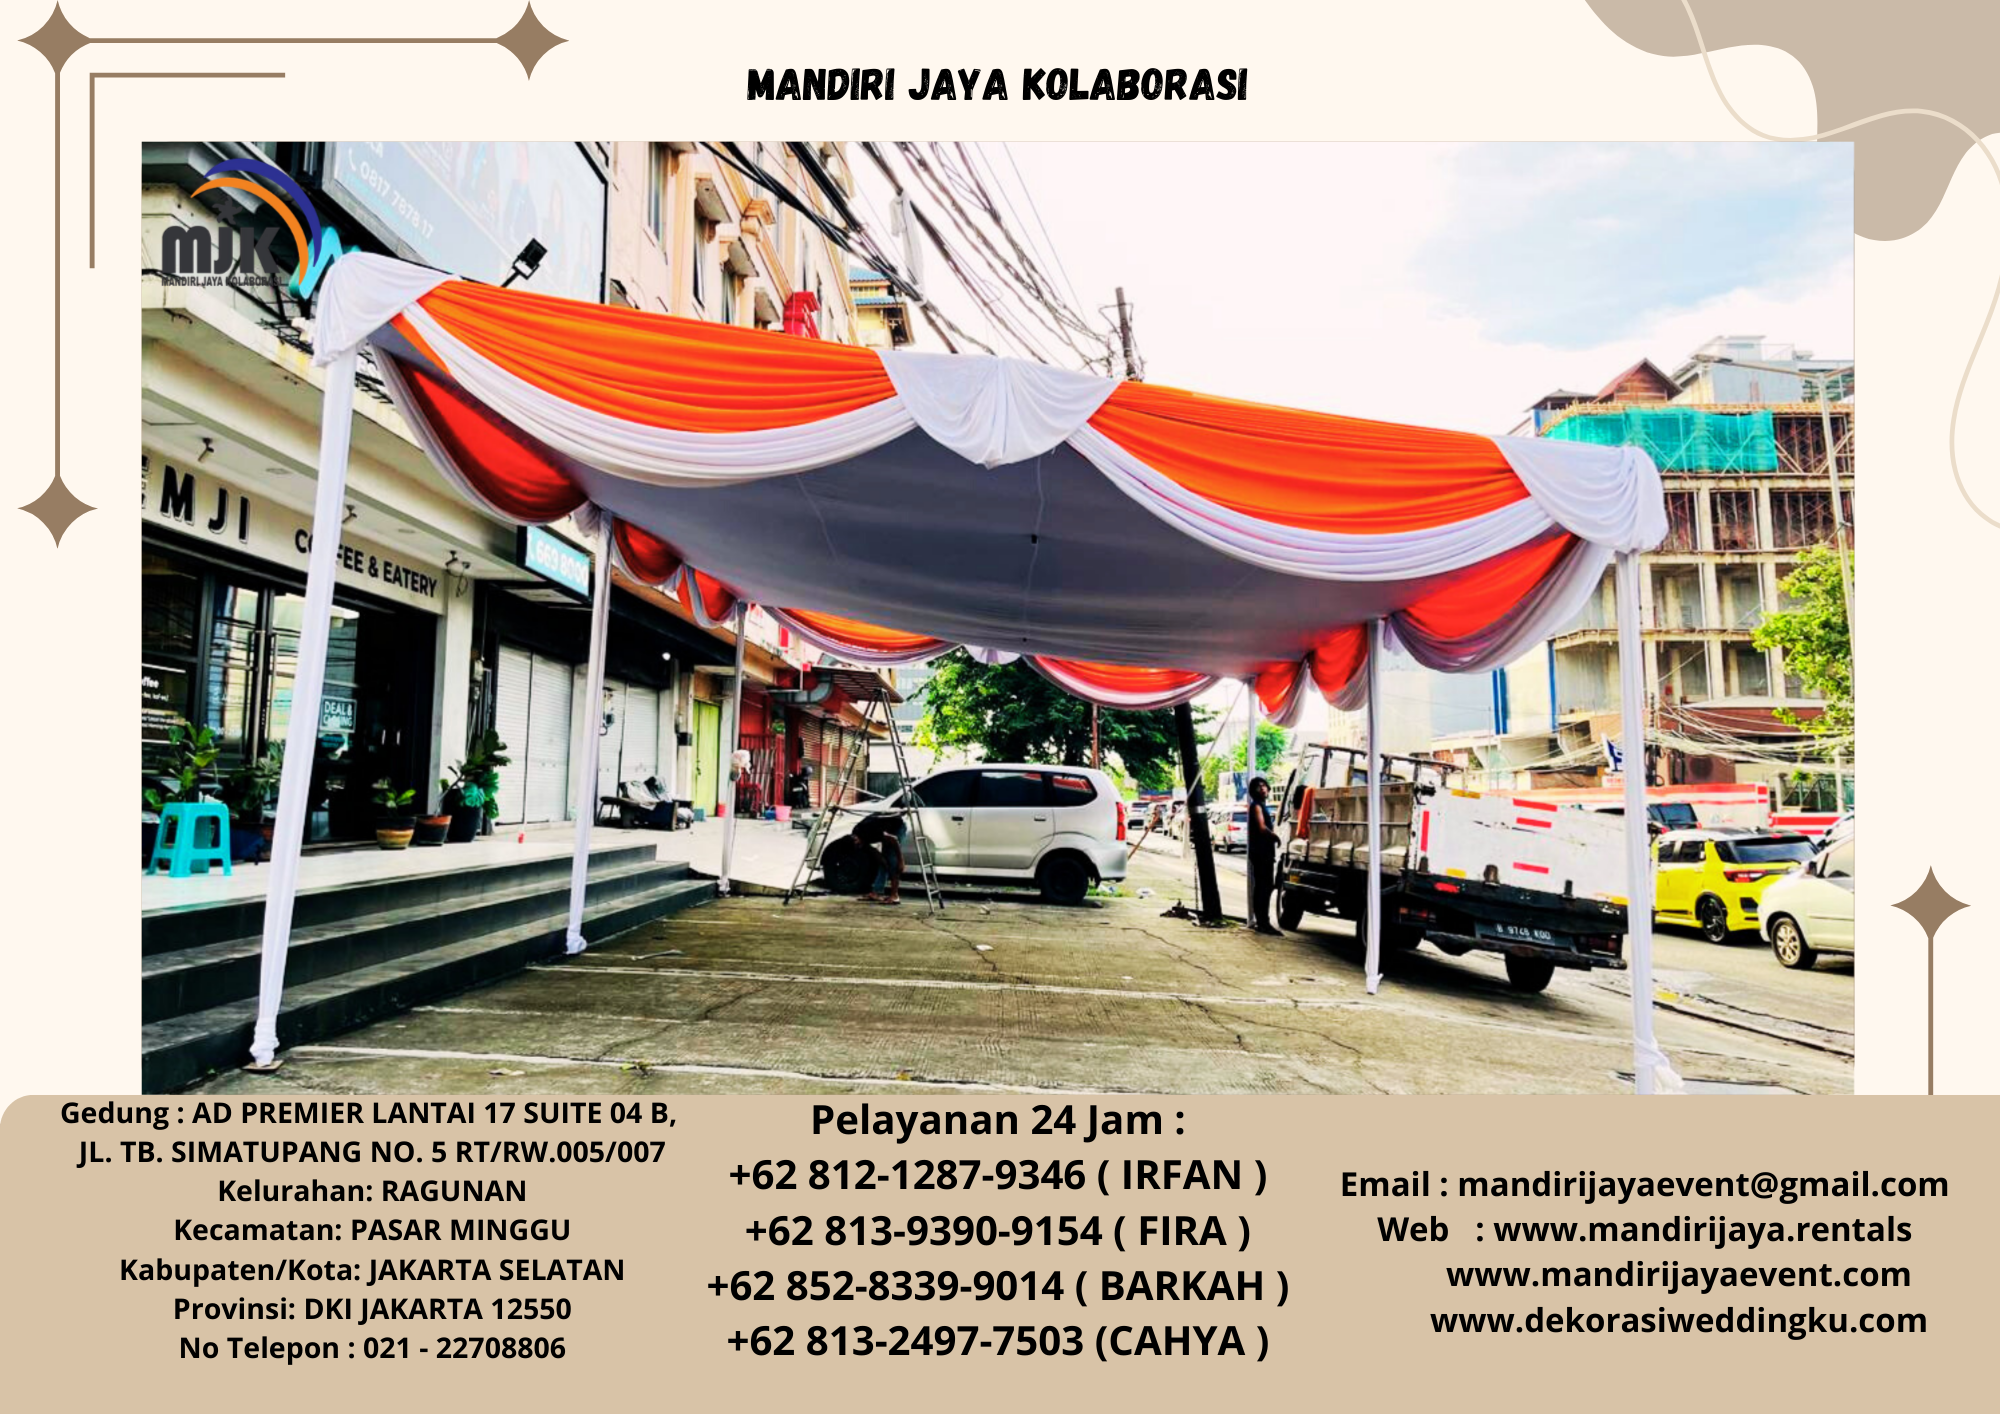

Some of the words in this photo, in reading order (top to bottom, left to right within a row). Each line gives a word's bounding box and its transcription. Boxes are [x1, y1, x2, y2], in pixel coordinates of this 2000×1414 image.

[295, 528, 364, 574] CEE
[368, 555, 378, 578] &
[383, 560, 437, 598] EATERY
[536, 540, 559, 571] 669
[560, 552, 588, 588] 8000
[325, 701, 345, 716] DEAL
